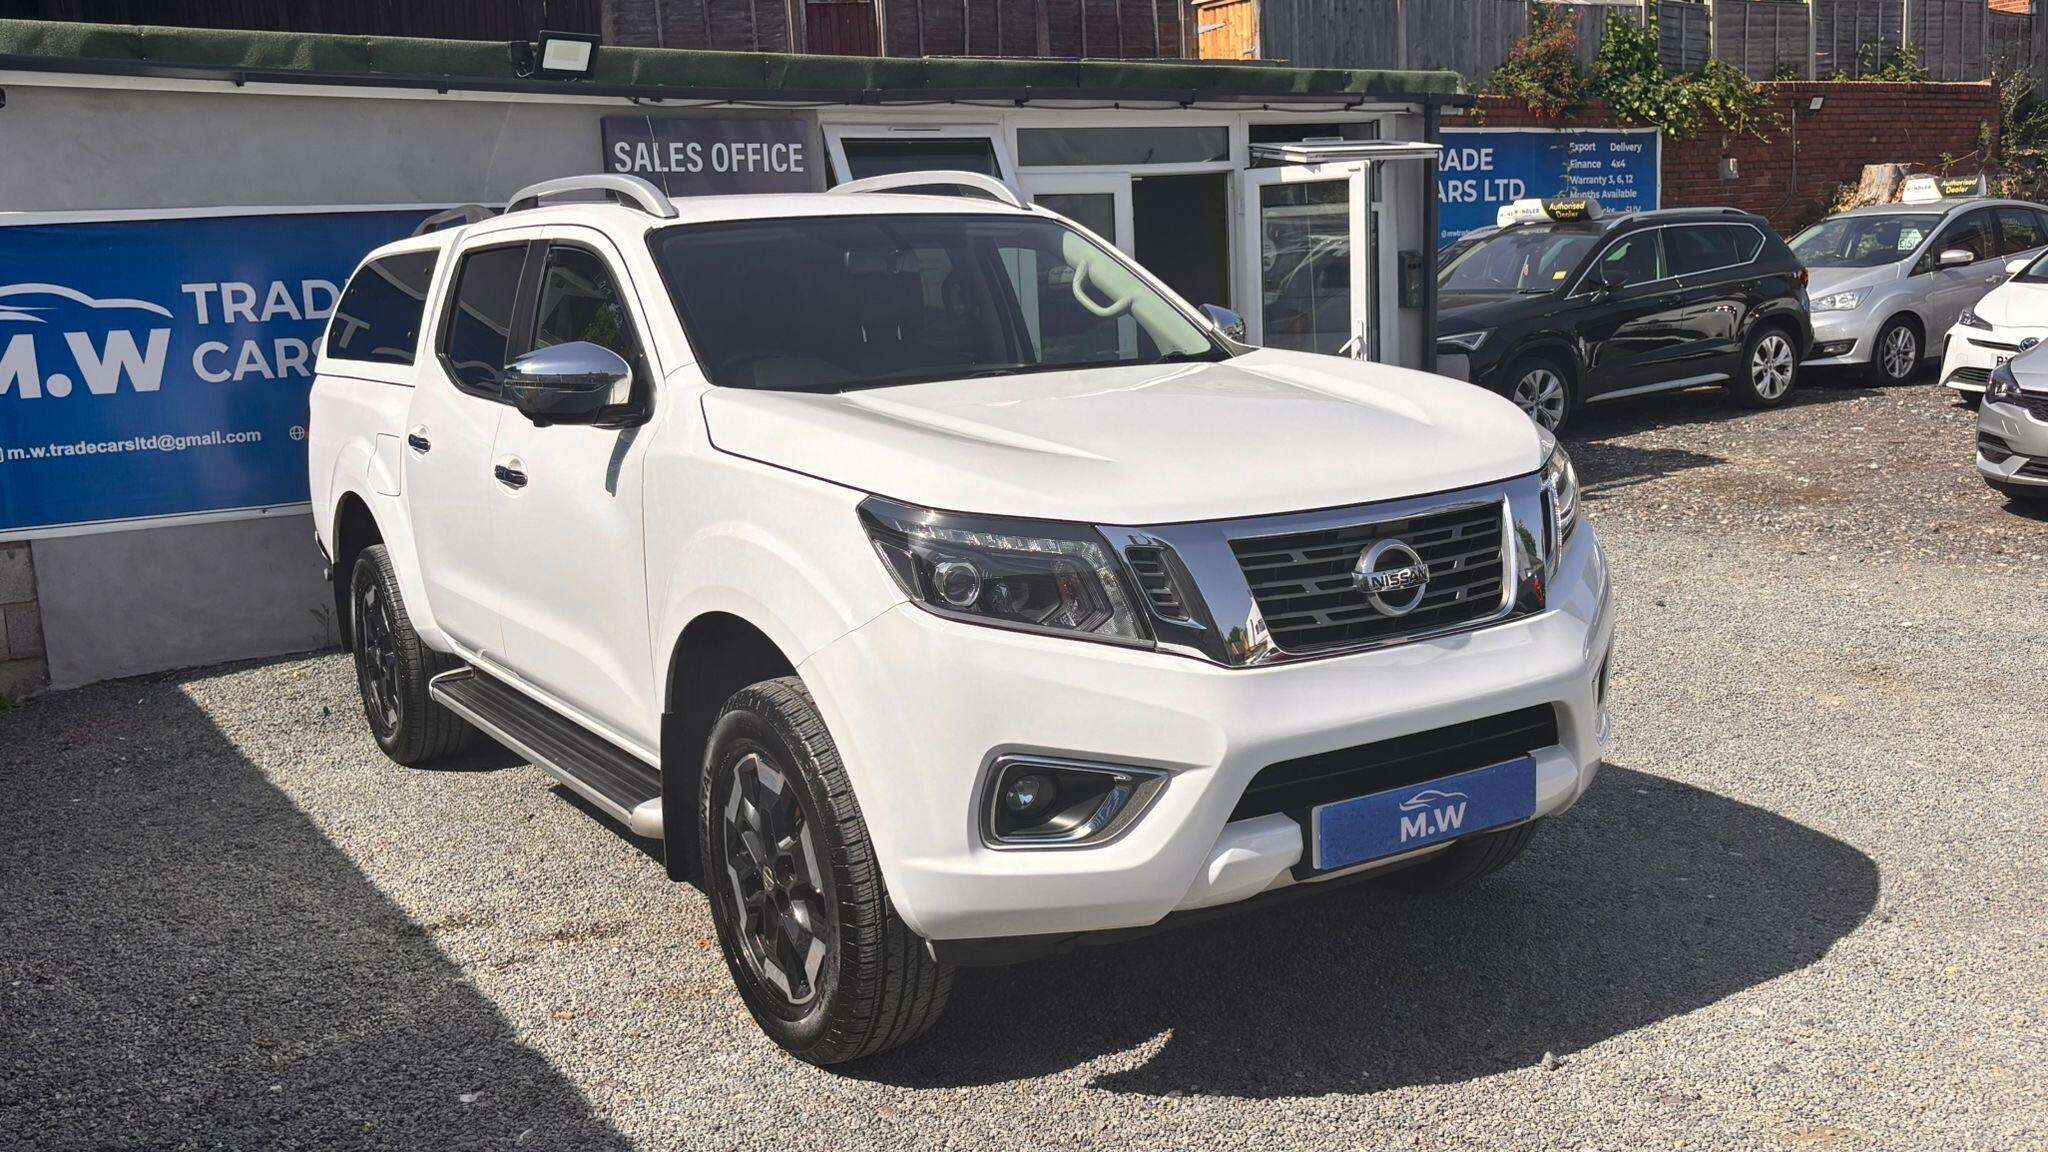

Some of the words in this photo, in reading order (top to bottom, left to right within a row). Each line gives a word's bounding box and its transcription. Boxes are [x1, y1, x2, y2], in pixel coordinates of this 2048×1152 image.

[614, 141, 704, 173] SALES
[711, 143, 804, 173] OFFICE
[1569, 142, 1596, 153] Export
[1610, 142, 1642, 153] Delivery
[1570, 159, 1602, 169] Finance
[1611, 159, 1626, 168] 4x4
[1484, 178, 1526, 202] LTD
[1569, 175, 1607, 187] Warranty
[1625, 174, 1634, 184] 12
[1548, 201, 1586, 211] Authorised
[1569, 190, 1600, 199] Months
[1601, 189, 1637, 199] Available
[181, 278, 350, 325] TRAD
[8, 430, 262, 461] m.w.tradecarsltd@gmail.com
[1370, 567, 1427, 591] NISSAN
[1400, 801, 1467, 843] M.W
